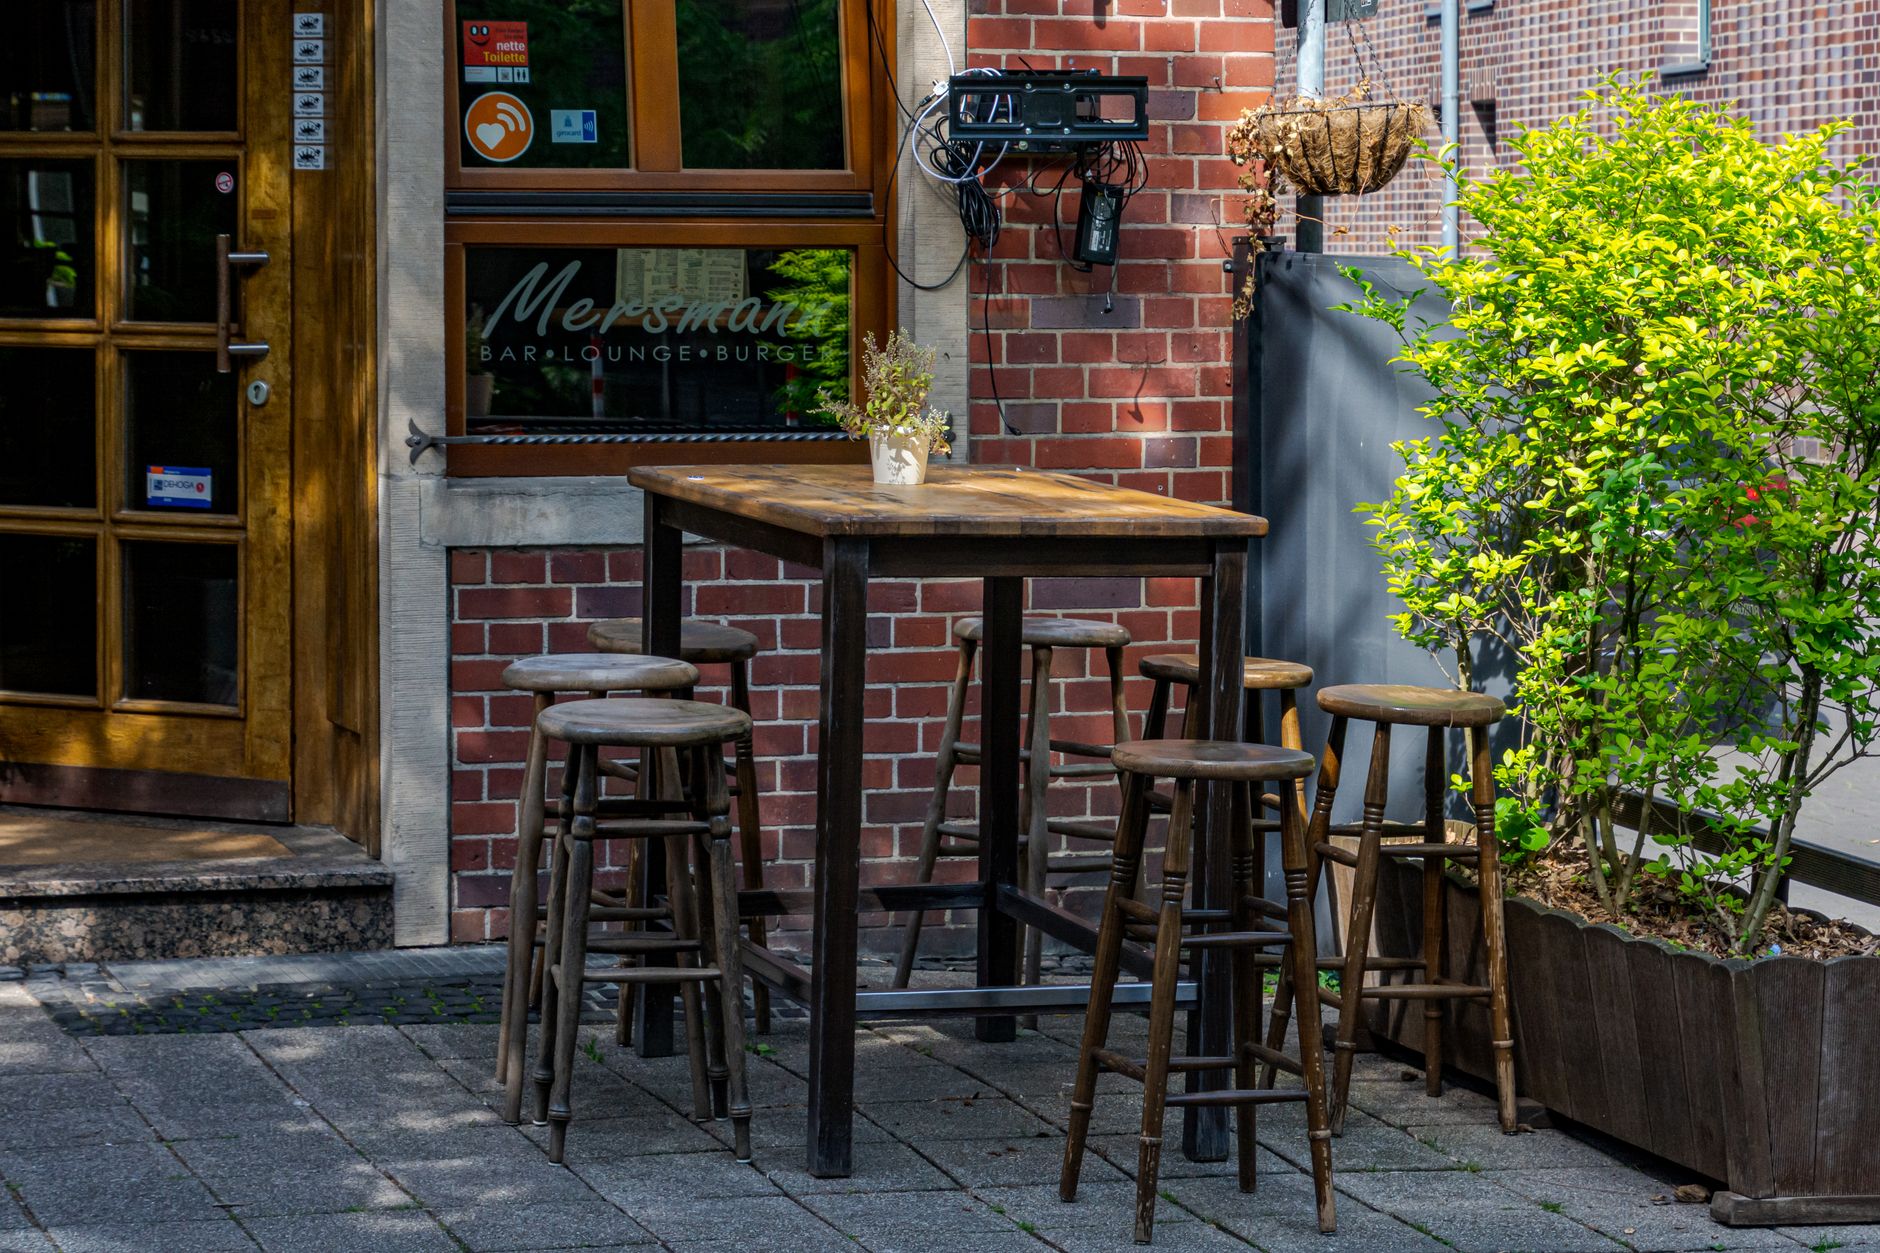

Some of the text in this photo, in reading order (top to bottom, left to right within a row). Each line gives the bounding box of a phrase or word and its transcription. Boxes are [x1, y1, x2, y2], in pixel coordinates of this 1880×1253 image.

[496, 41, 526, 51] nette
[483, 51, 526, 63] Toilette
[480, 345, 537, 362] BAR
[564, 345, 691, 363] LOUNGE
